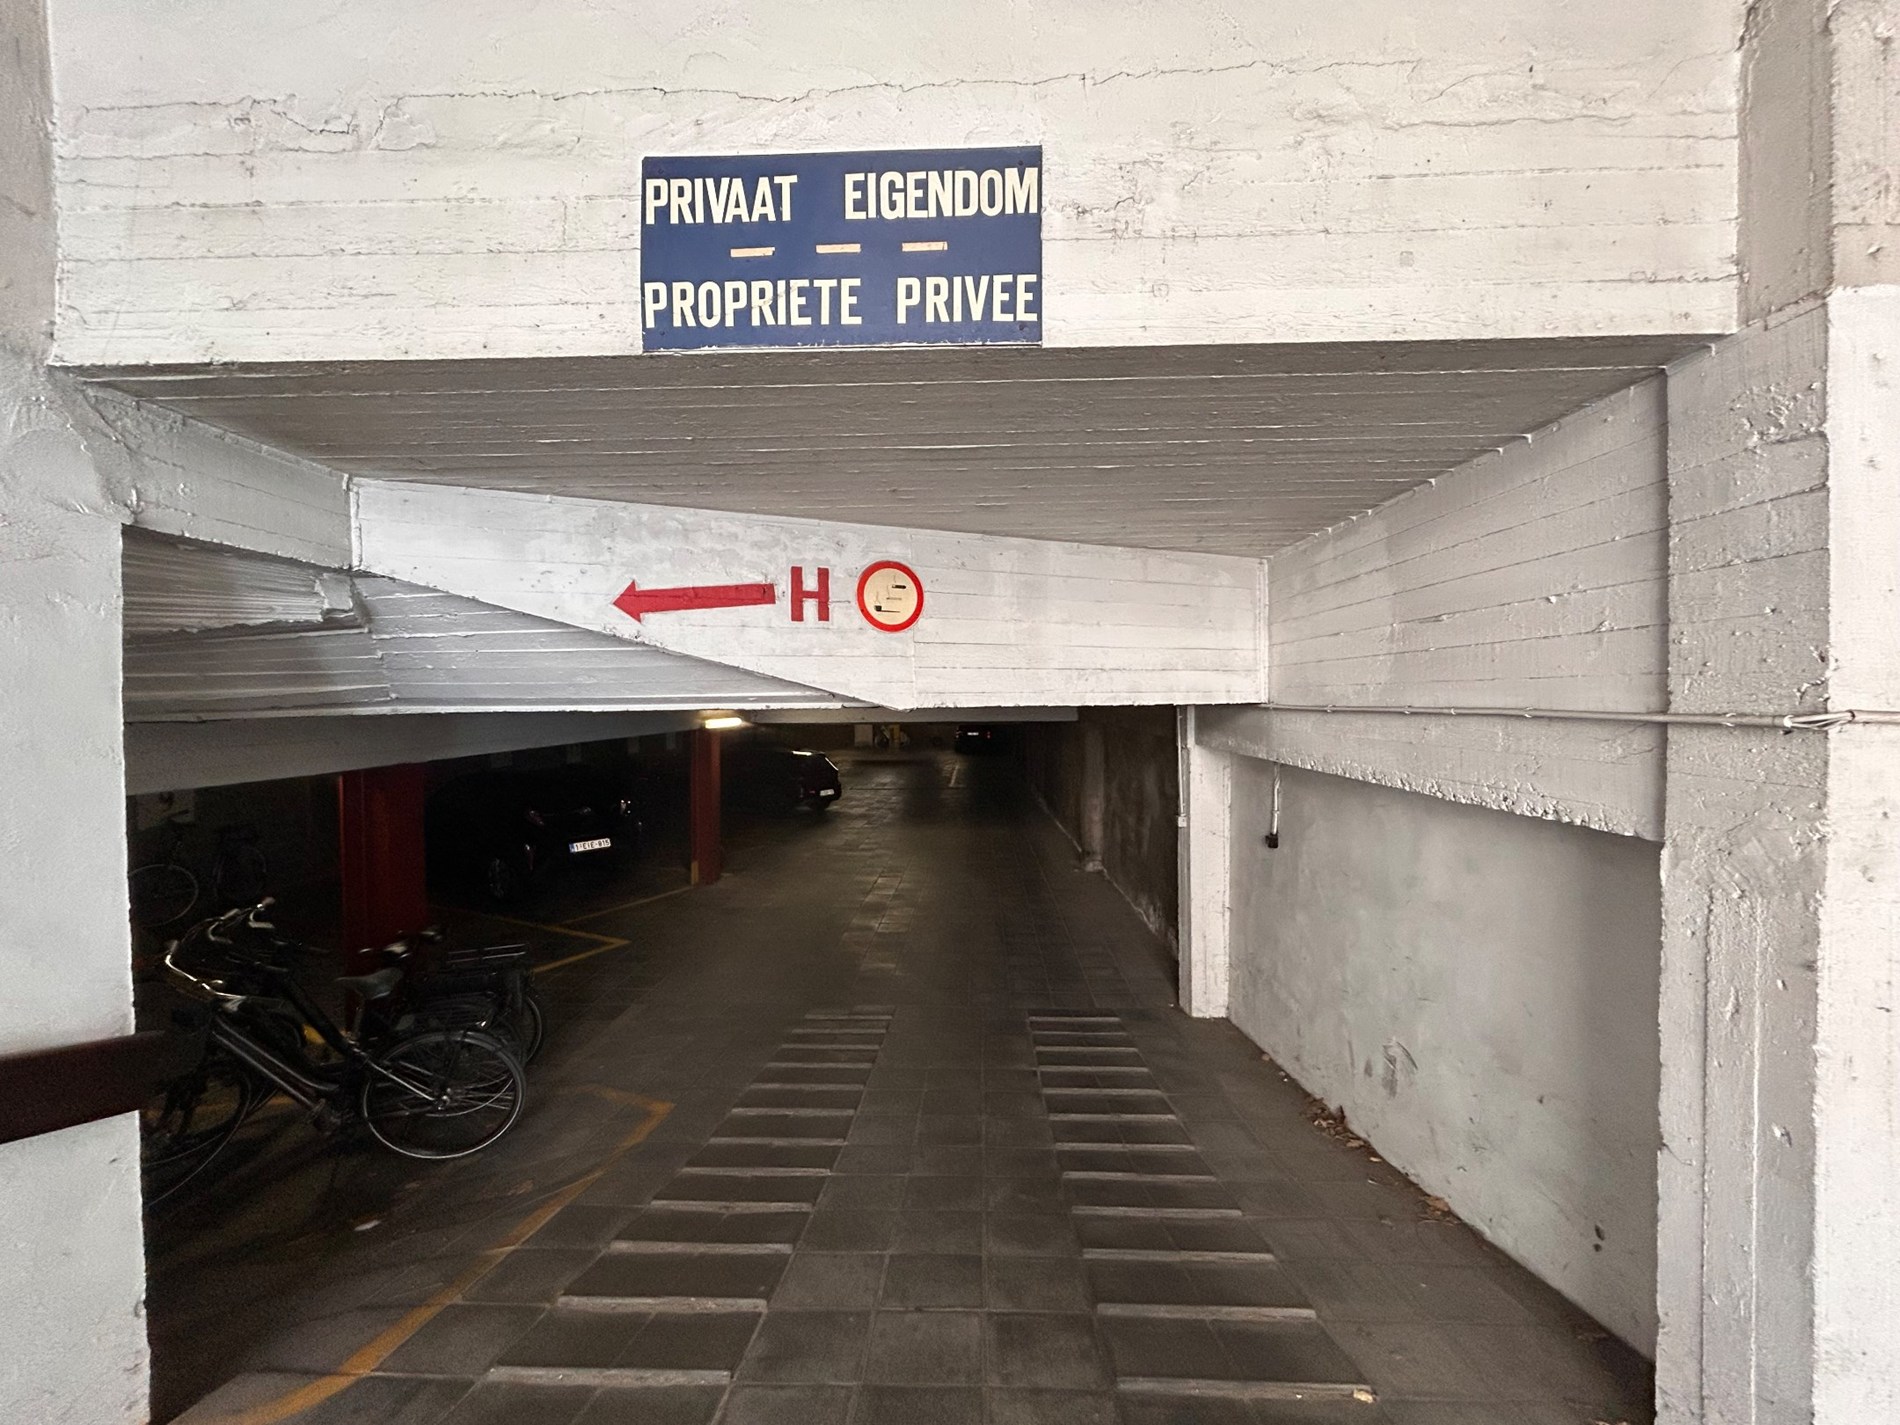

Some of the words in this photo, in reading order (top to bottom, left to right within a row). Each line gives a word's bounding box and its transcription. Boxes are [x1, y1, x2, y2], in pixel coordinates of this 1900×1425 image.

[645, 174, 798, 225] PRIVAAT
[844, 167, 1039, 220] EIGENDOM
[643, 278, 862, 329] PROPRIETE
[896, 274, 1038, 325] PRIVEE
[791, 566, 829, 622] H
